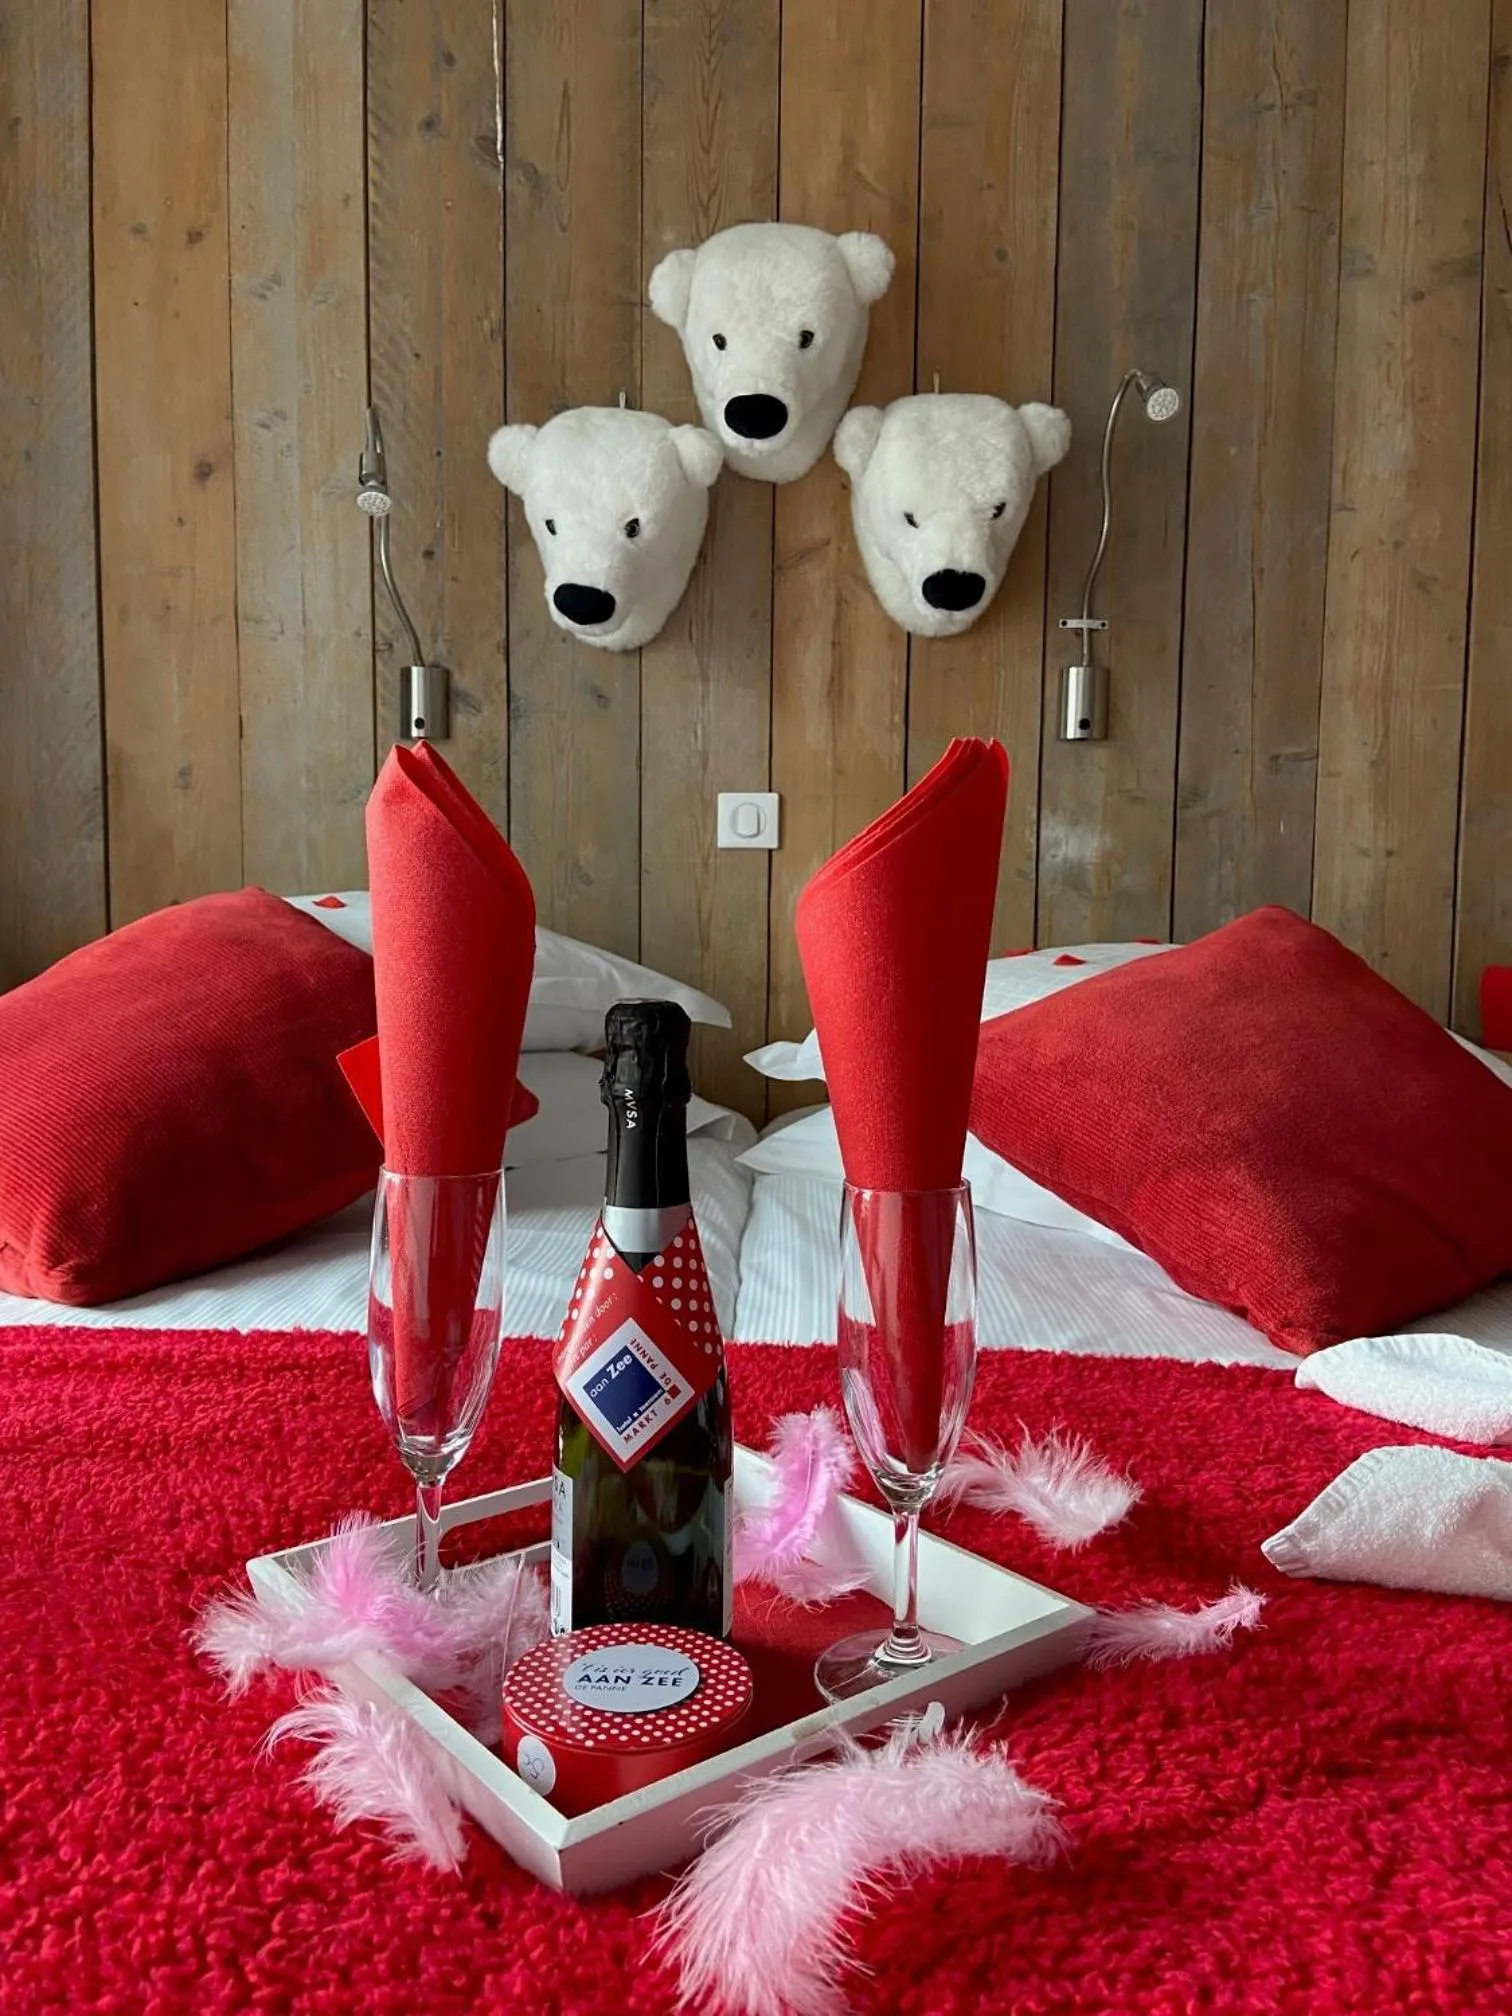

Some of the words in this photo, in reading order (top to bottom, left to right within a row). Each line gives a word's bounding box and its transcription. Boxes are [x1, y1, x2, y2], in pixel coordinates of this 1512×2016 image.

[624, 1088, 638, 1129] MVSA
[629, 1338, 659, 1371] PANNE
[589, 1378, 610, 1398] aan
[606, 1353, 632, 1380] Zee
[659, 1371, 672, 1386] DE
[622, 1408, 658, 1444] MARKT
[577, 1674, 632, 1685] AAN
[641, 1676, 683, 1688] ZEE
